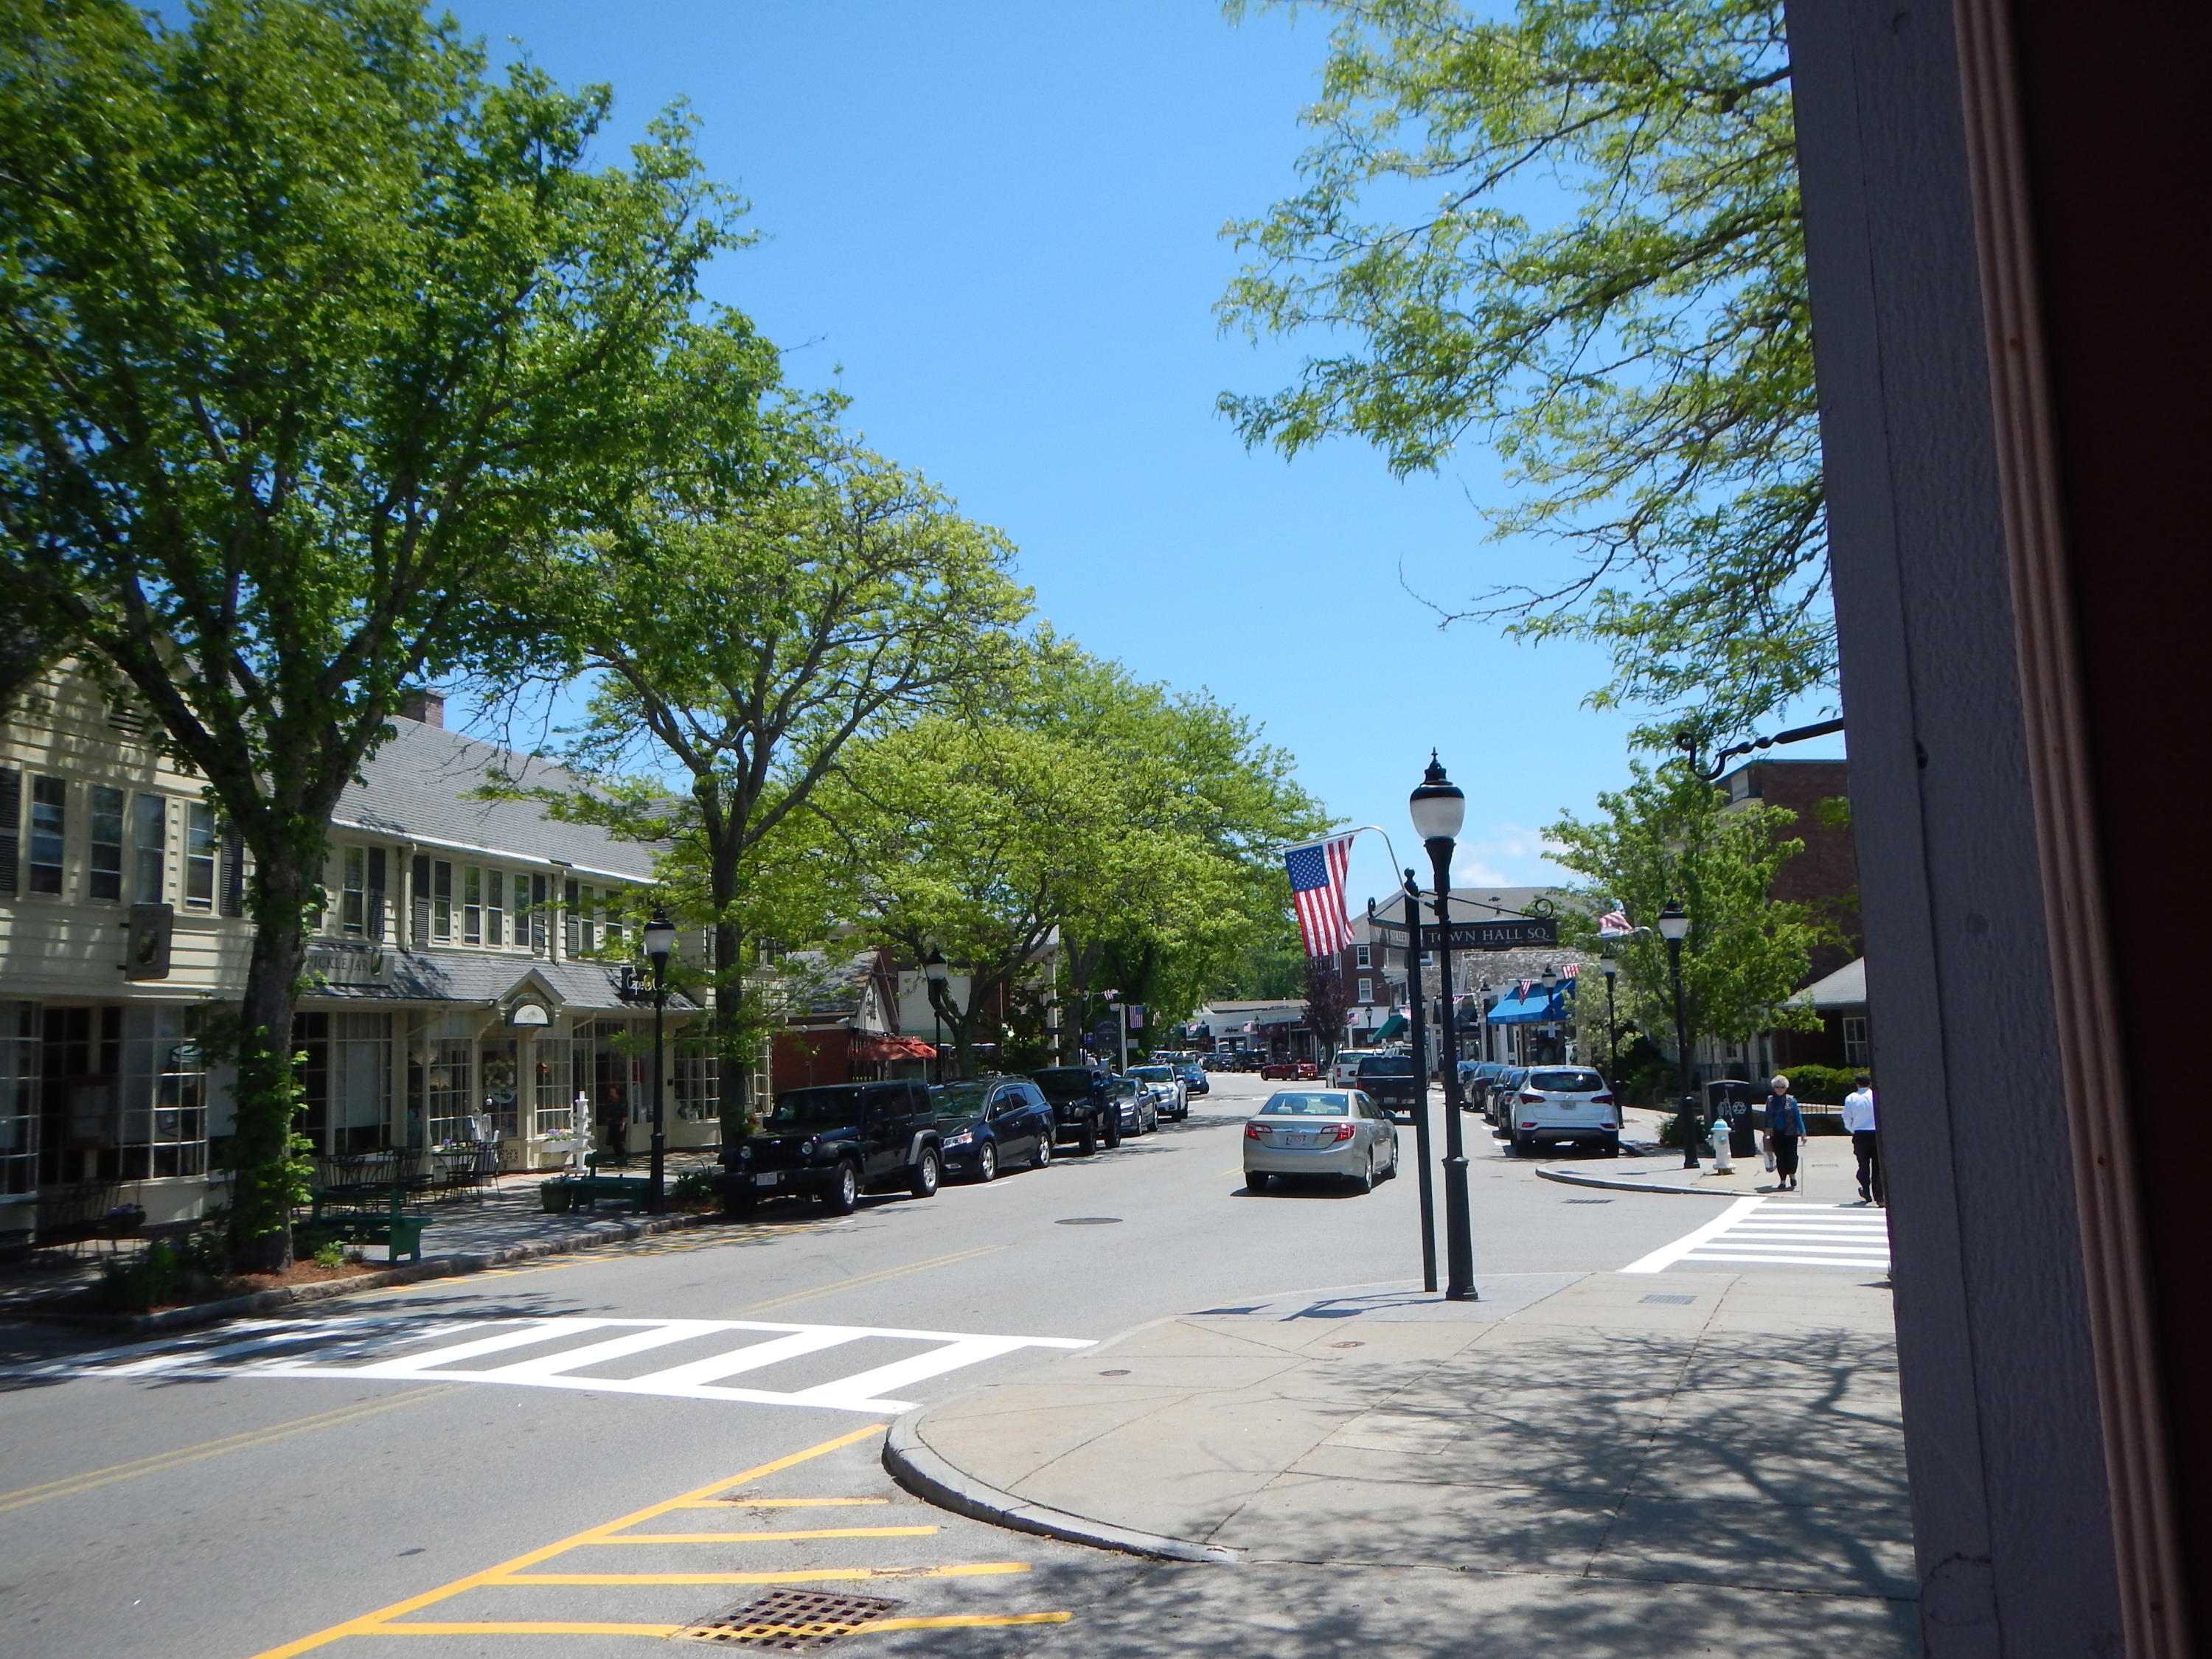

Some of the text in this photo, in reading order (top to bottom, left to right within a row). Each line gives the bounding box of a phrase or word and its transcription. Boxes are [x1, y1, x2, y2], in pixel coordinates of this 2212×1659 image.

[1427, 927, 1554, 944] TWN HALL SQ.
[307, 956, 369, 973] PICKLE JAR
